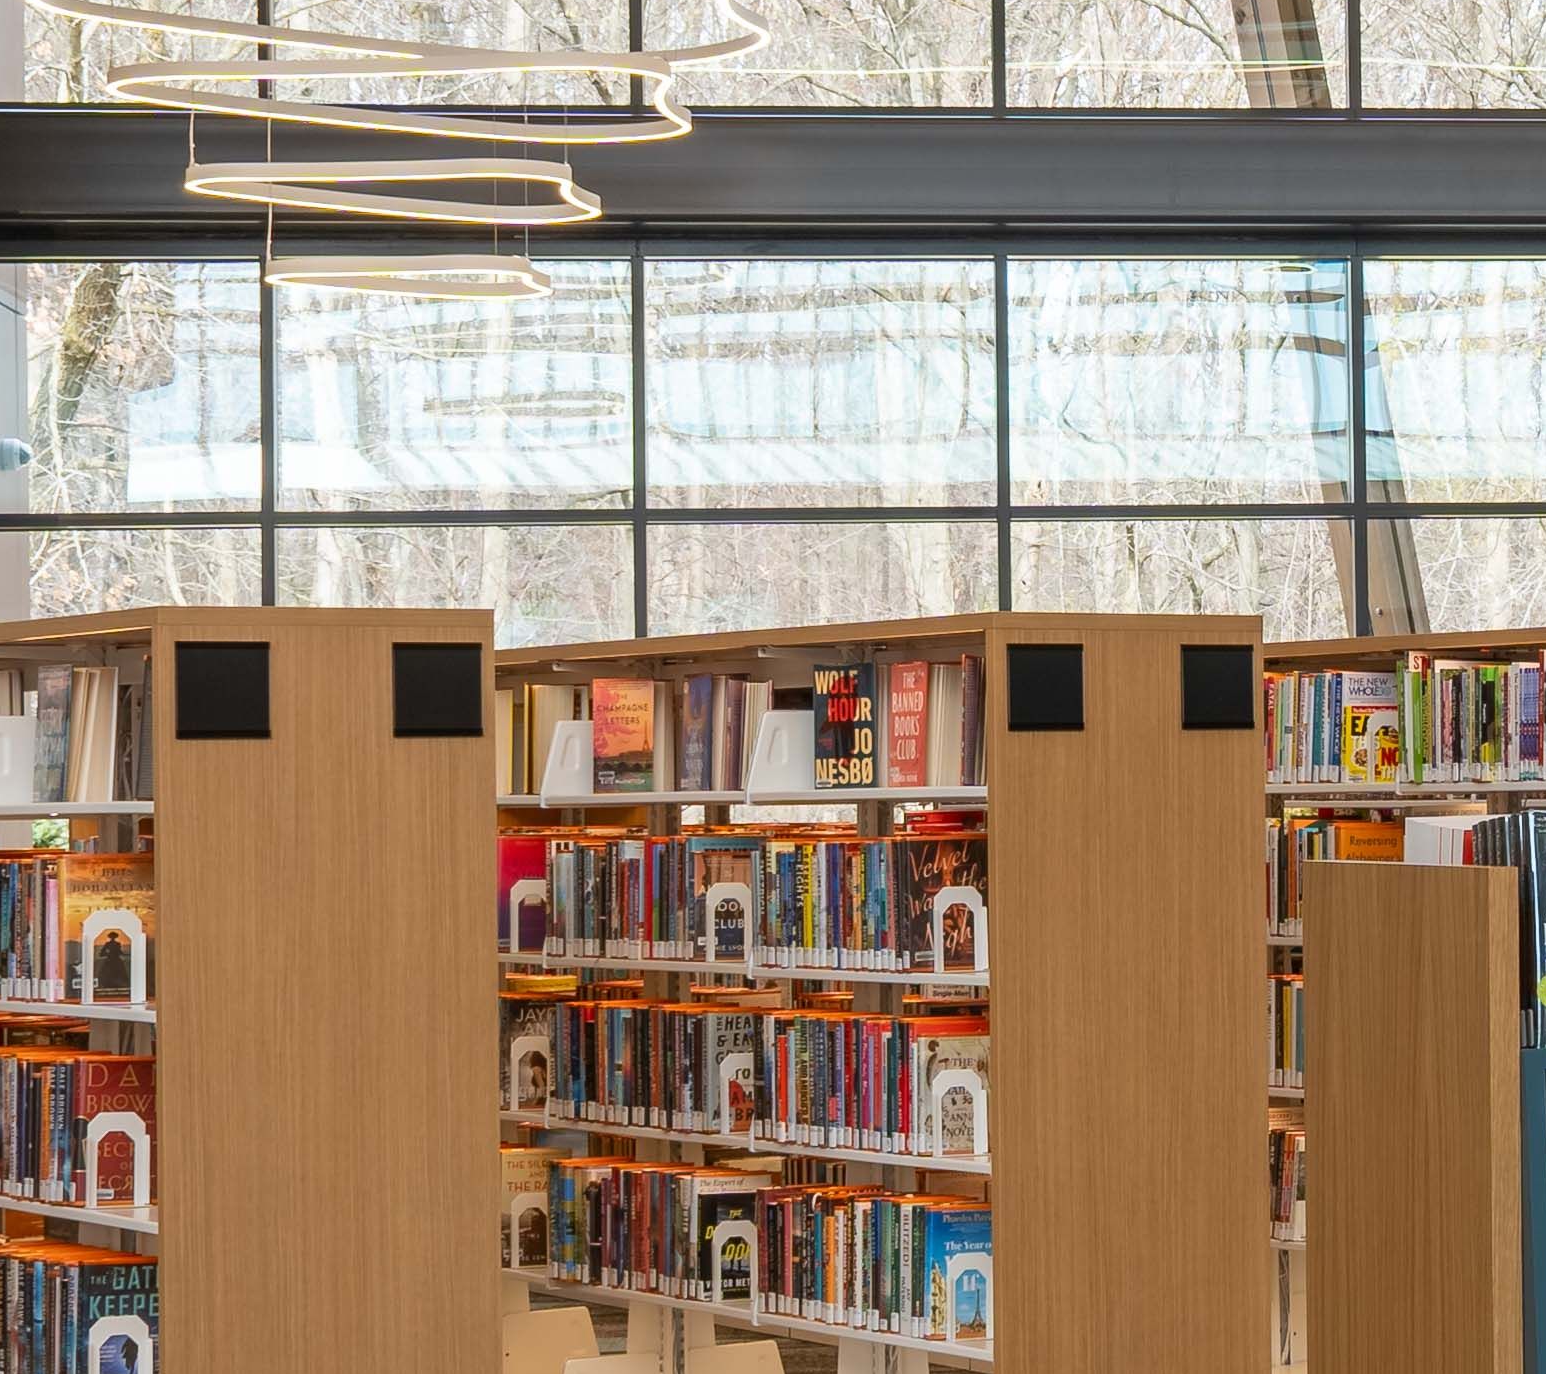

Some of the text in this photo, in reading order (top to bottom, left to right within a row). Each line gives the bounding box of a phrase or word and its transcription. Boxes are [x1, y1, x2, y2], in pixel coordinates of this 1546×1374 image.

[814, 670, 858, 695] WOLF
[902, 672, 916, 689] THE
[1348, 677, 1388, 686] THE NEW
[595, 702, 649, 713] CHAMPAGNE
[827, 697, 872, 722] HOUR
[892, 691, 923, 712] BANNED
[603, 714, 641, 725] LETTERS
[894, 715, 920, 737] BOOKS
[852, 727, 873, 755] JO
[896, 739, 917, 761] CLUB
[1350, 835, 1397, 848] Reversing
[909, 842, 970, 881] Velvet
